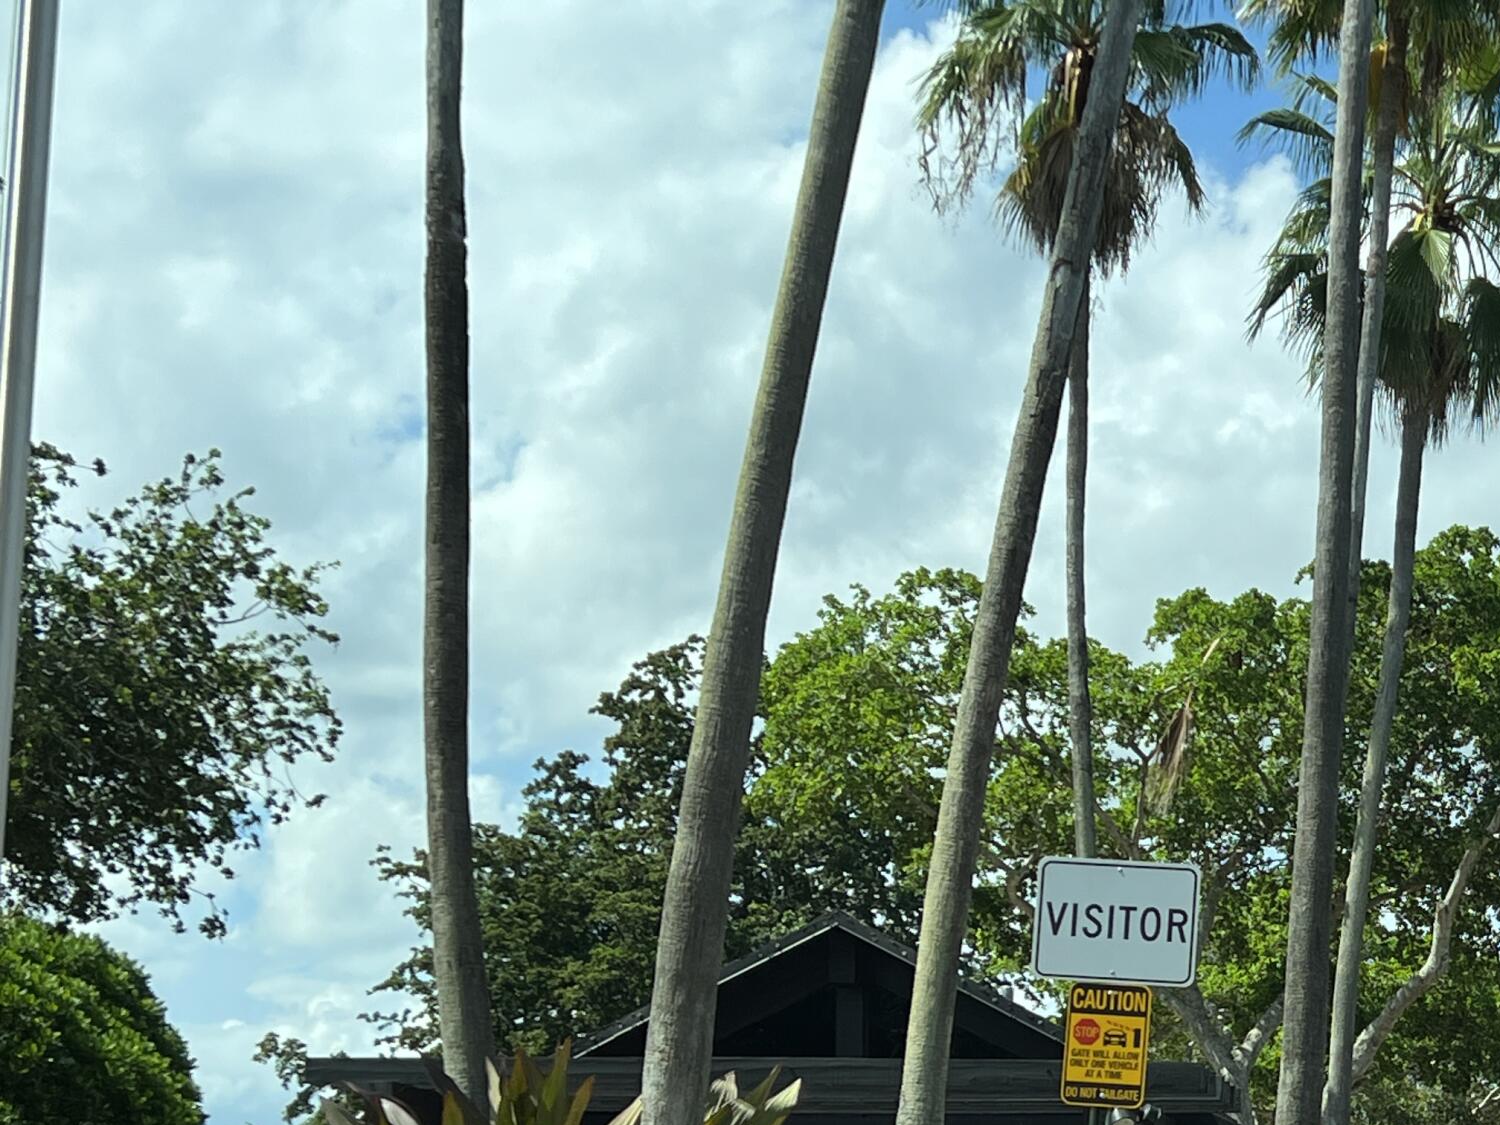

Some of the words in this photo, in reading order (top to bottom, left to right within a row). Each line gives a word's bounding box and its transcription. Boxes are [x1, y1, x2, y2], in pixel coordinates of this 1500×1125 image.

[1047, 901, 1188, 943] VISITOR
[1073, 988, 1147, 1012] CAUTION
[1075, 1027, 1099, 1038] STOP
[1071, 1048, 1090, 1057] GATE
[1093, 1050, 1110, 1059] WILL
[1113, 1051, 1139, 1060] ALLOW
[1070, 1059, 1089, 1067] ONLY
[1091, 1060, 1106, 1069] ONE
[1108, 1061, 1139, 1071] VEHICLE
[1085, 1069, 1094, 1077] AT
[1096, 1070, 1102, 1078] A
[1104, 1070, 1123, 1080] TIME
[1065, 1086, 1078, 1097] DO
[1080, 1087, 1098, 1099] NOT
